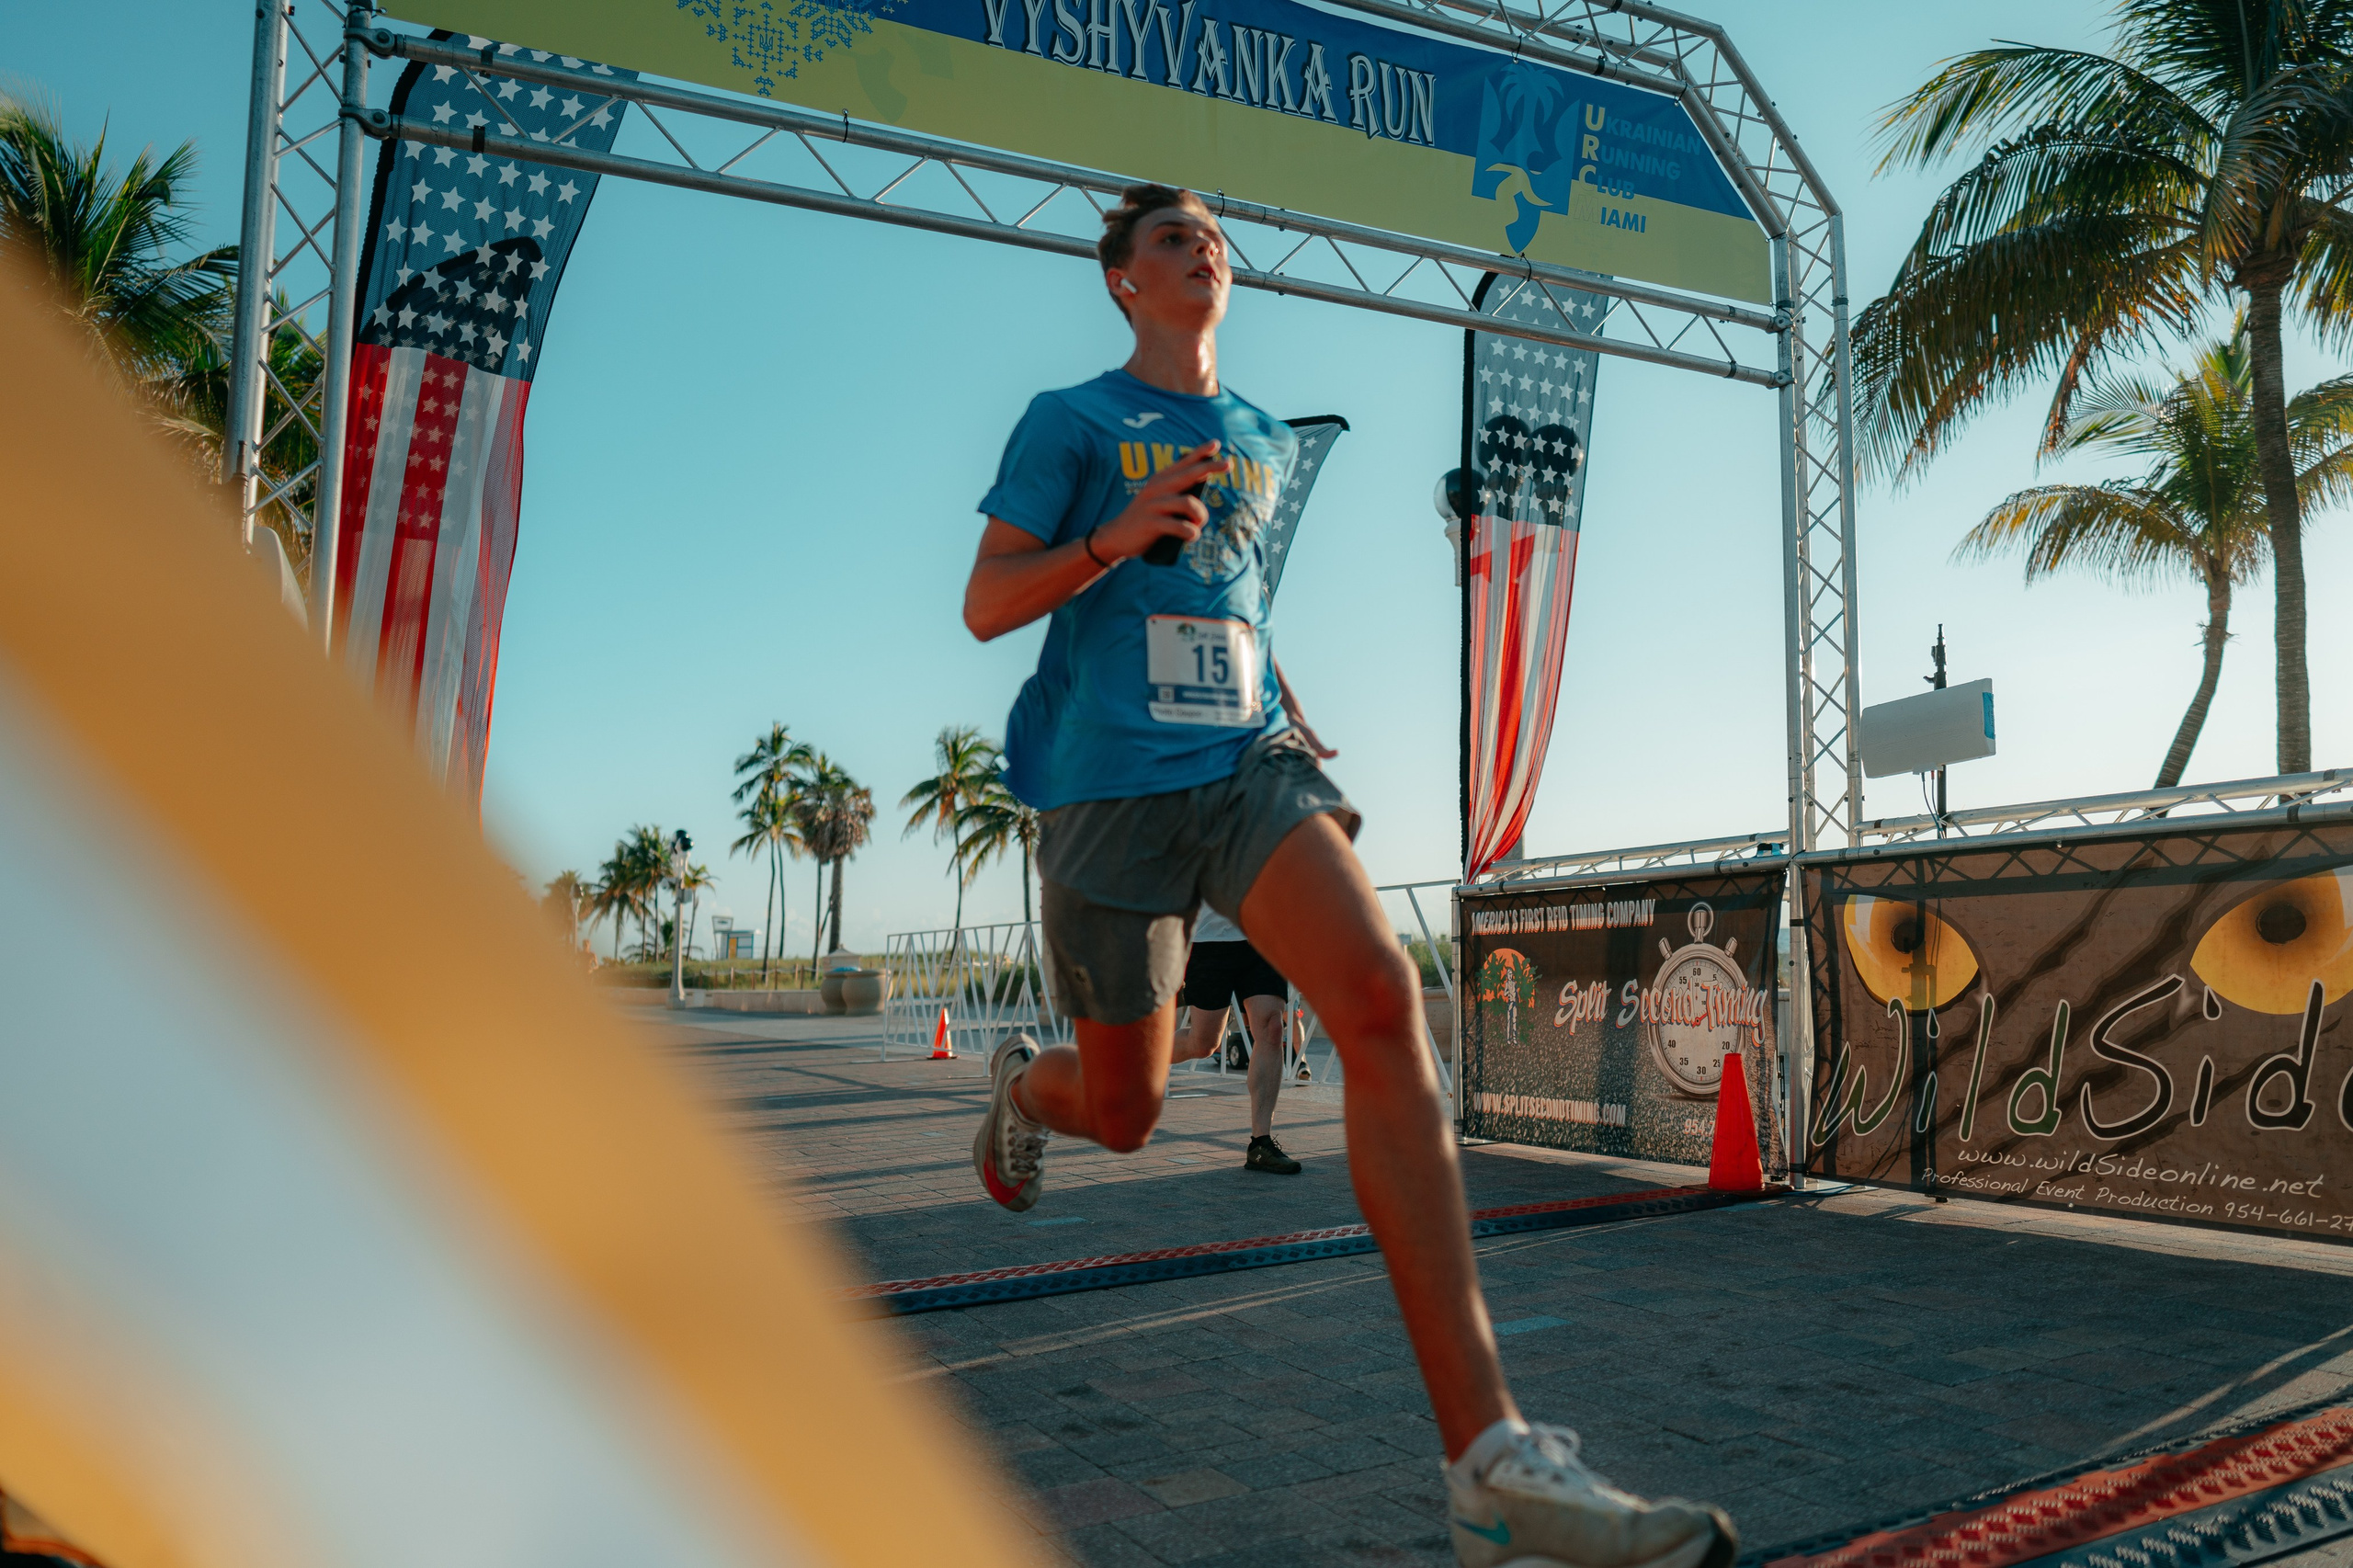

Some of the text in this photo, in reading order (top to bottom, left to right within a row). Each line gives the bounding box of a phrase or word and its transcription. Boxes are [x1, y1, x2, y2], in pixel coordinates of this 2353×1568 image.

[1349, 53, 1437, 145] RUN
[1585, 104, 1700, 155] UKRAINIAN
[1582, 134, 1681, 180] RUNNING
[1578, 165, 1635, 200] CLUB
[1192, 644, 1229, 684] 15
[1471, 899, 1655, 936] AMERICA'S FIRST RFID TIMING COMPANY
[1553, 976, 1768, 1048] Split Second Timing
[1811, 973, 2353, 1147] WildSid
[1472, 1092, 1626, 1127] WWW.SPLITSECONDTIMING.COM
[1683, 1119, 1715, 1137] 954.7
[1921, 1167, 2029, 1194] Professional
[2036, 1180, 2085, 1200] Event
[2095, 1186, 2213, 1215] Production
